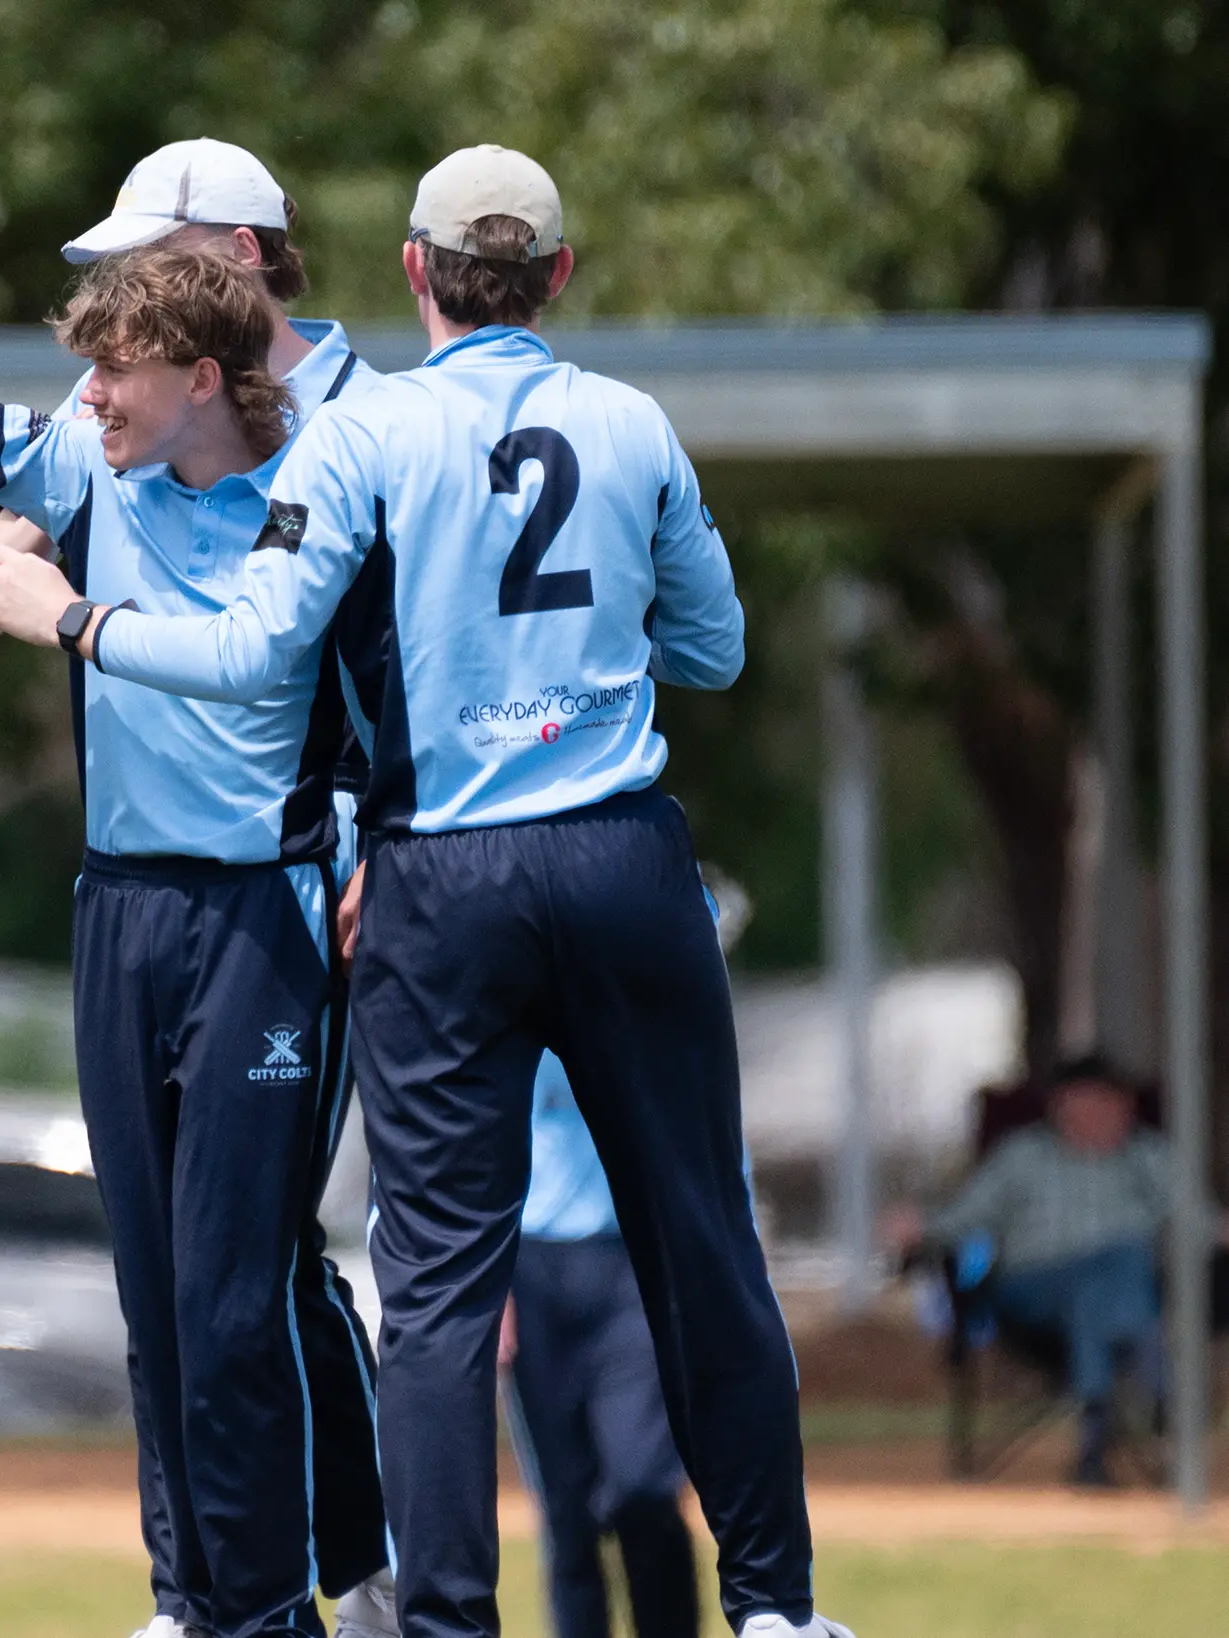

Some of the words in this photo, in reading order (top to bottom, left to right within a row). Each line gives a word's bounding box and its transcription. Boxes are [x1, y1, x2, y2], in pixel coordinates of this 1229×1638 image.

[488, 426, 594, 617] 2
[459, 698, 551, 726] EVERYDAY
[560, 680, 640, 715] GOURMET
[539, 685, 569, 698] YOUR
[248, 1068, 277, 1080] CITY
